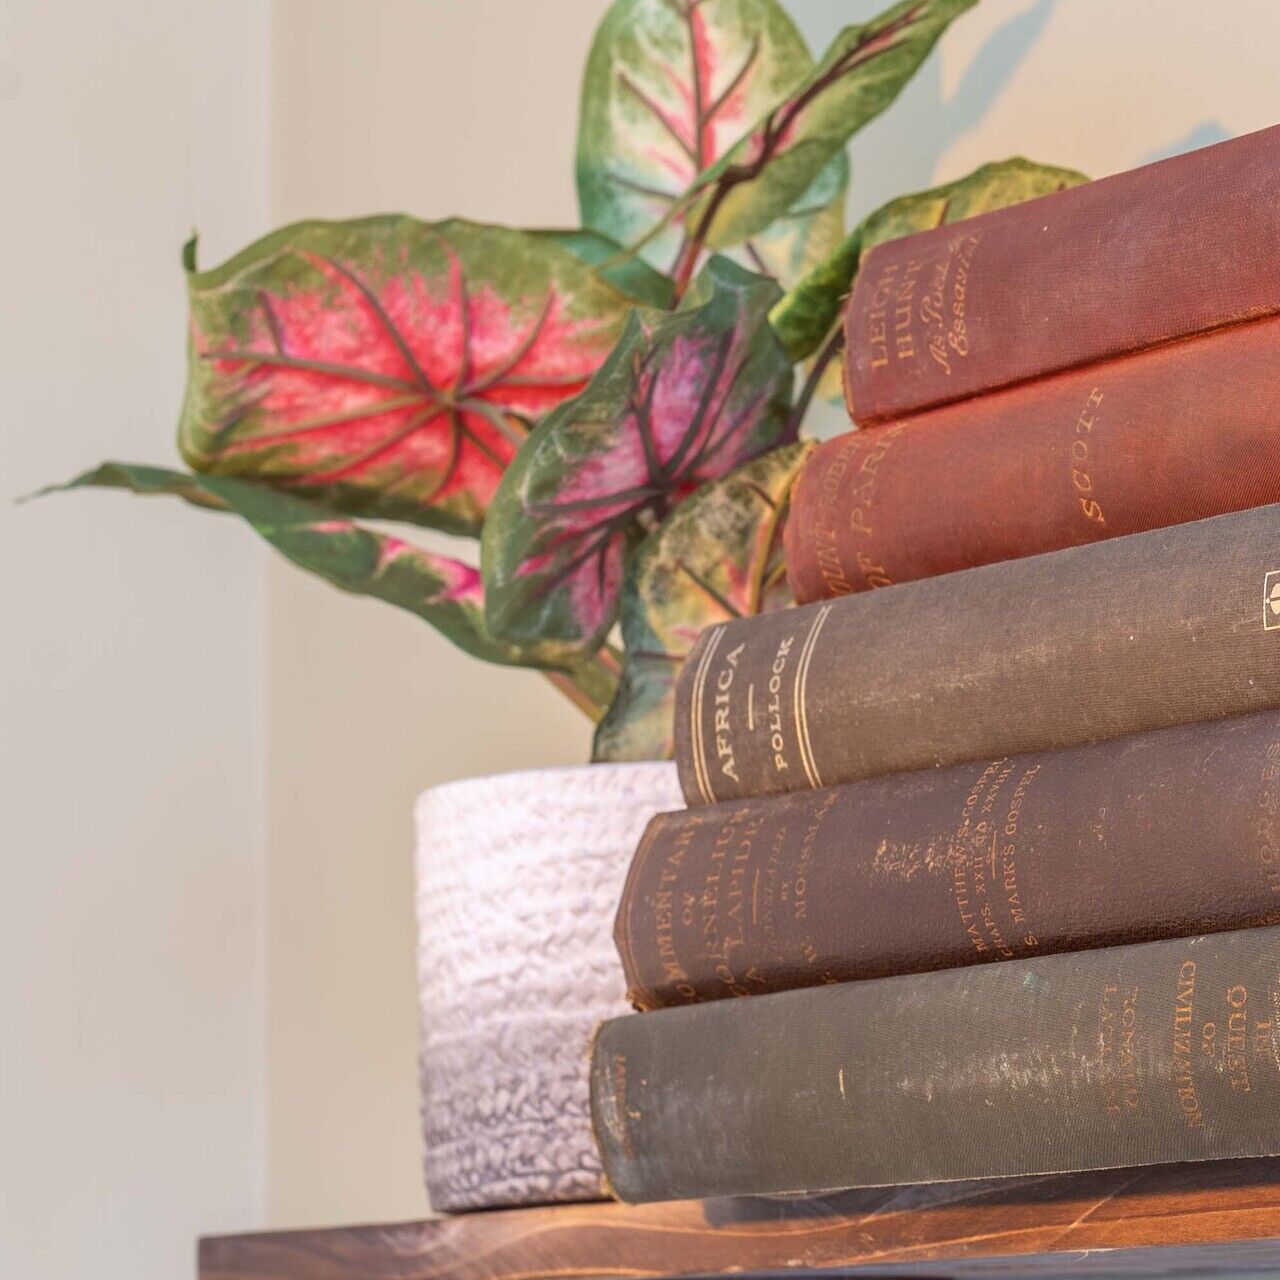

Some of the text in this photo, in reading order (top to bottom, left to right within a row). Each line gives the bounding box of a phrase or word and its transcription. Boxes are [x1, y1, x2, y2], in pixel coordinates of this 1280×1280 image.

[870, 265, 899, 367] LEIGH
[896, 260, 923, 359] HUNT
[921, 262, 950, 329] Poet
[1072, 387, 1105, 525] SCOTT
[813, 522, 852, 597] OUNT
[715, 642, 746, 783] AFRICA
[768, 636, 794, 770] POLLOCK
[1005, 765, 1042, 835] GOSPEL
[656, 816, 703, 998] OMMENTARY
[1003, 844, 1025, 926] MARK'S
[1174, 960, 1205, 1127] CIVILIZATION
[1226, 984, 1251, 1094] QUEST
